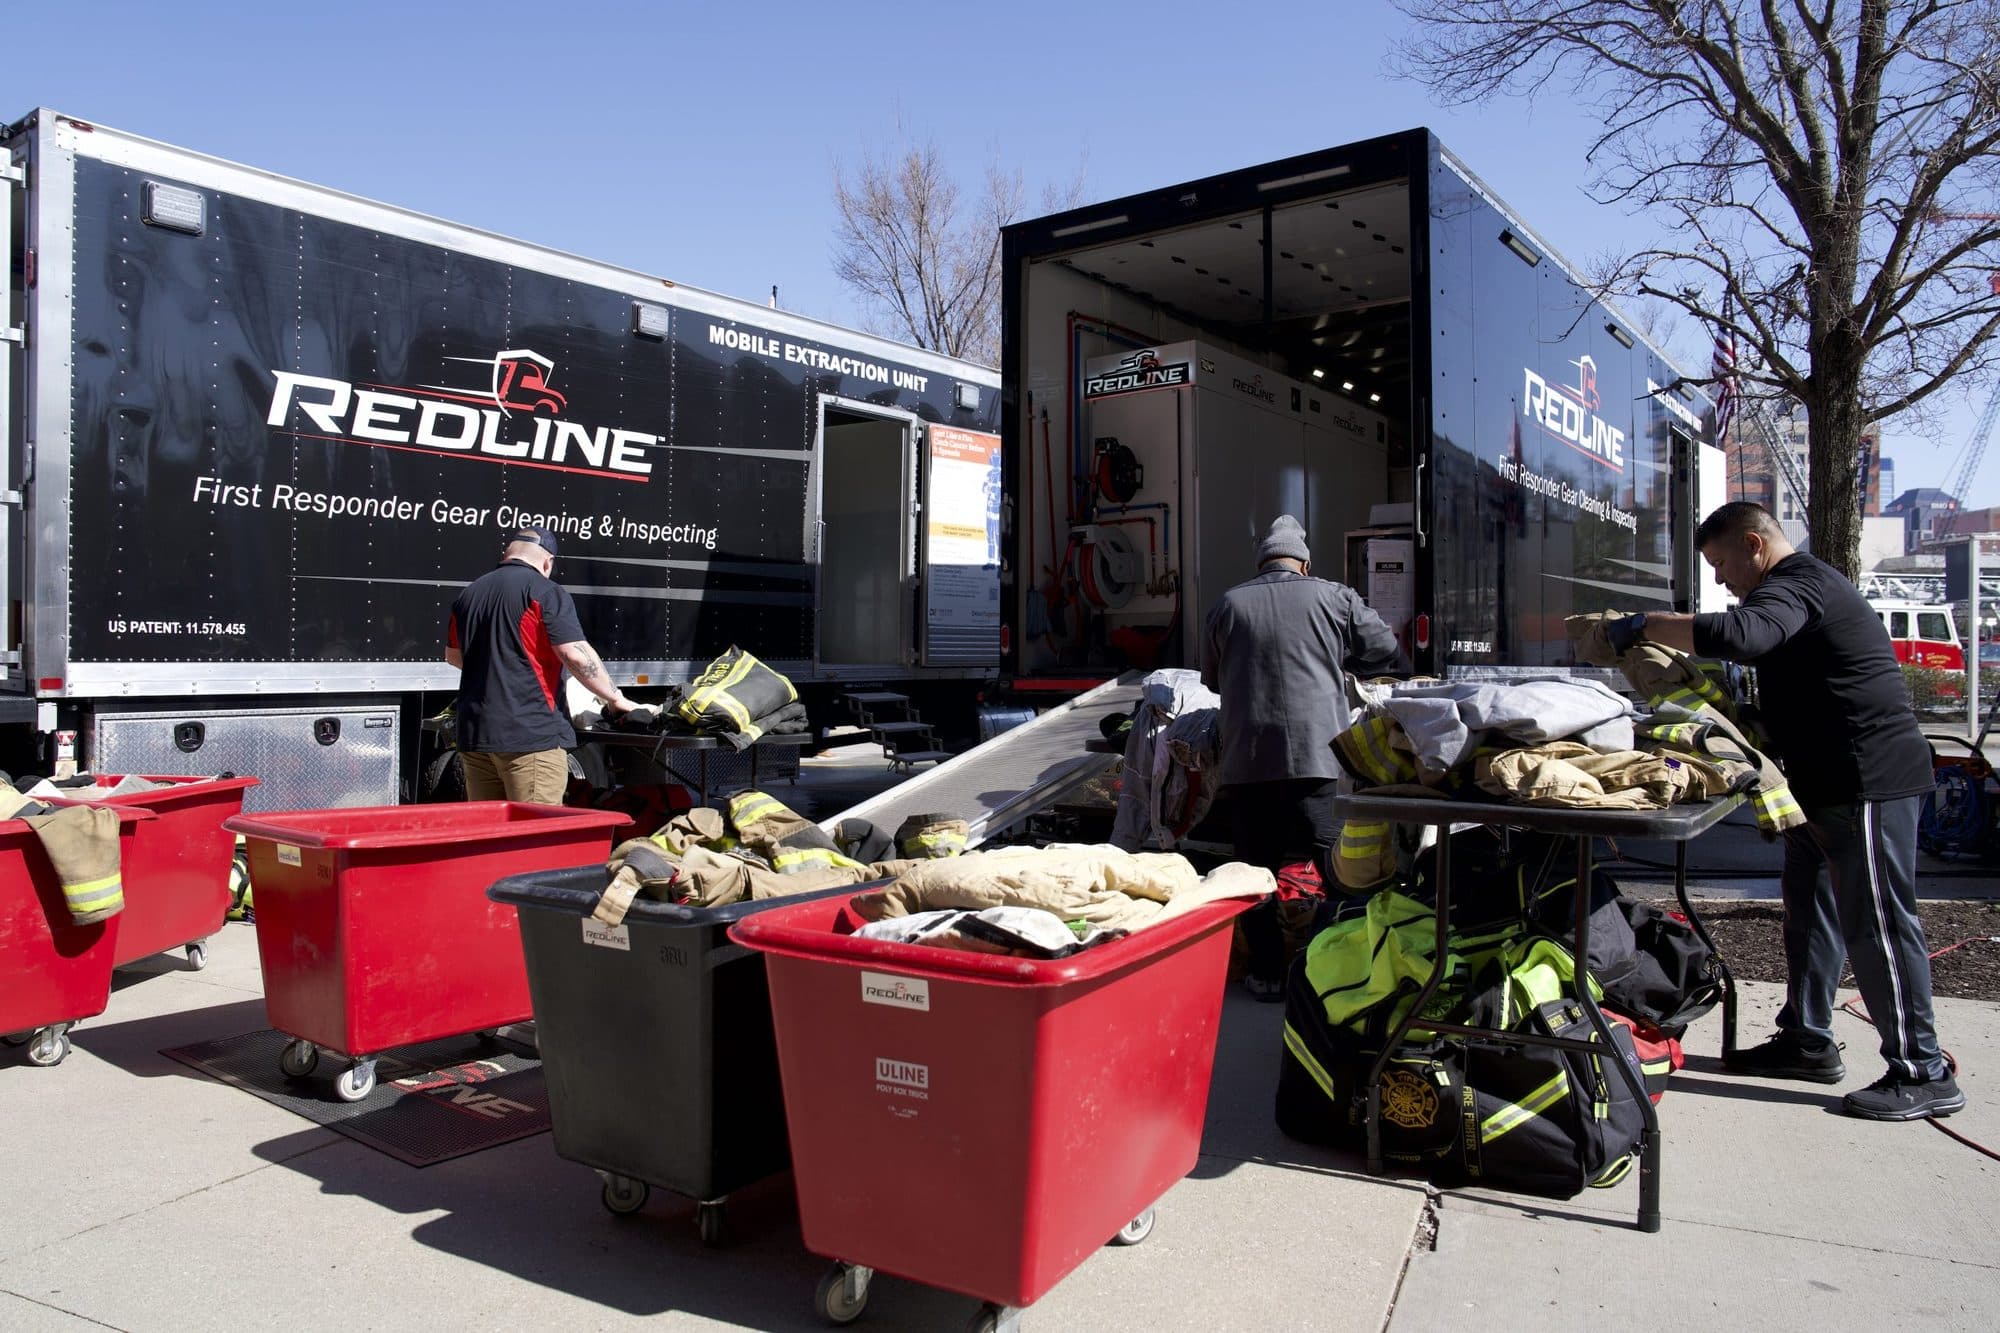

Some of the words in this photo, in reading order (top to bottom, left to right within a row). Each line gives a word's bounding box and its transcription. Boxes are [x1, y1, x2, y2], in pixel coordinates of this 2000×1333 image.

[709, 325, 780, 358] MOBILE
[785, 343, 888, 384] EXTRACTION
[893, 370, 928, 392] UNIT
[1087, 368, 1184, 394] REDLINE
[1232, 378, 1276, 402] REDLINE
[267, 369, 658, 473] REDLINE
[1524, 368, 1625, 467] REDLINE
[1499, 455, 1518, 483] First
[1520, 464, 1560, 499] Responder
[1561, 482, 1578, 506] Gear
[1579, 489, 1605, 522] Cleaning
[1605, 501, 1611, 520] &
[1611, 504, 1637, 534] Inspecting
[192, 476, 263, 508] First
[272, 484, 424, 520] Responder
[431, 499, 490, 527] Gear
[496, 505, 594, 540] Cleaning
[599, 515, 615, 537] &
[620, 517, 718, 550] Inspecting
[108, 620, 127, 633] US
[130, 621, 182, 634] PATENT:
[186, 622, 246, 635] 11.578.455
[585, 930, 627, 945] REDLINE
[866, 986, 926, 1004] REDLINE
[879, 1062, 925, 1084] ULINE
[1399, 1074, 1419, 1083] FIRE
[876, 1084, 893, 1094] POLY
[893, 1086, 907, 1096] BOX
[908, 1089, 929, 1100] TRUCK
[1463, 1085, 1474, 1107] FIRE
[1464, 1112, 1477, 1150] FIGHTER
